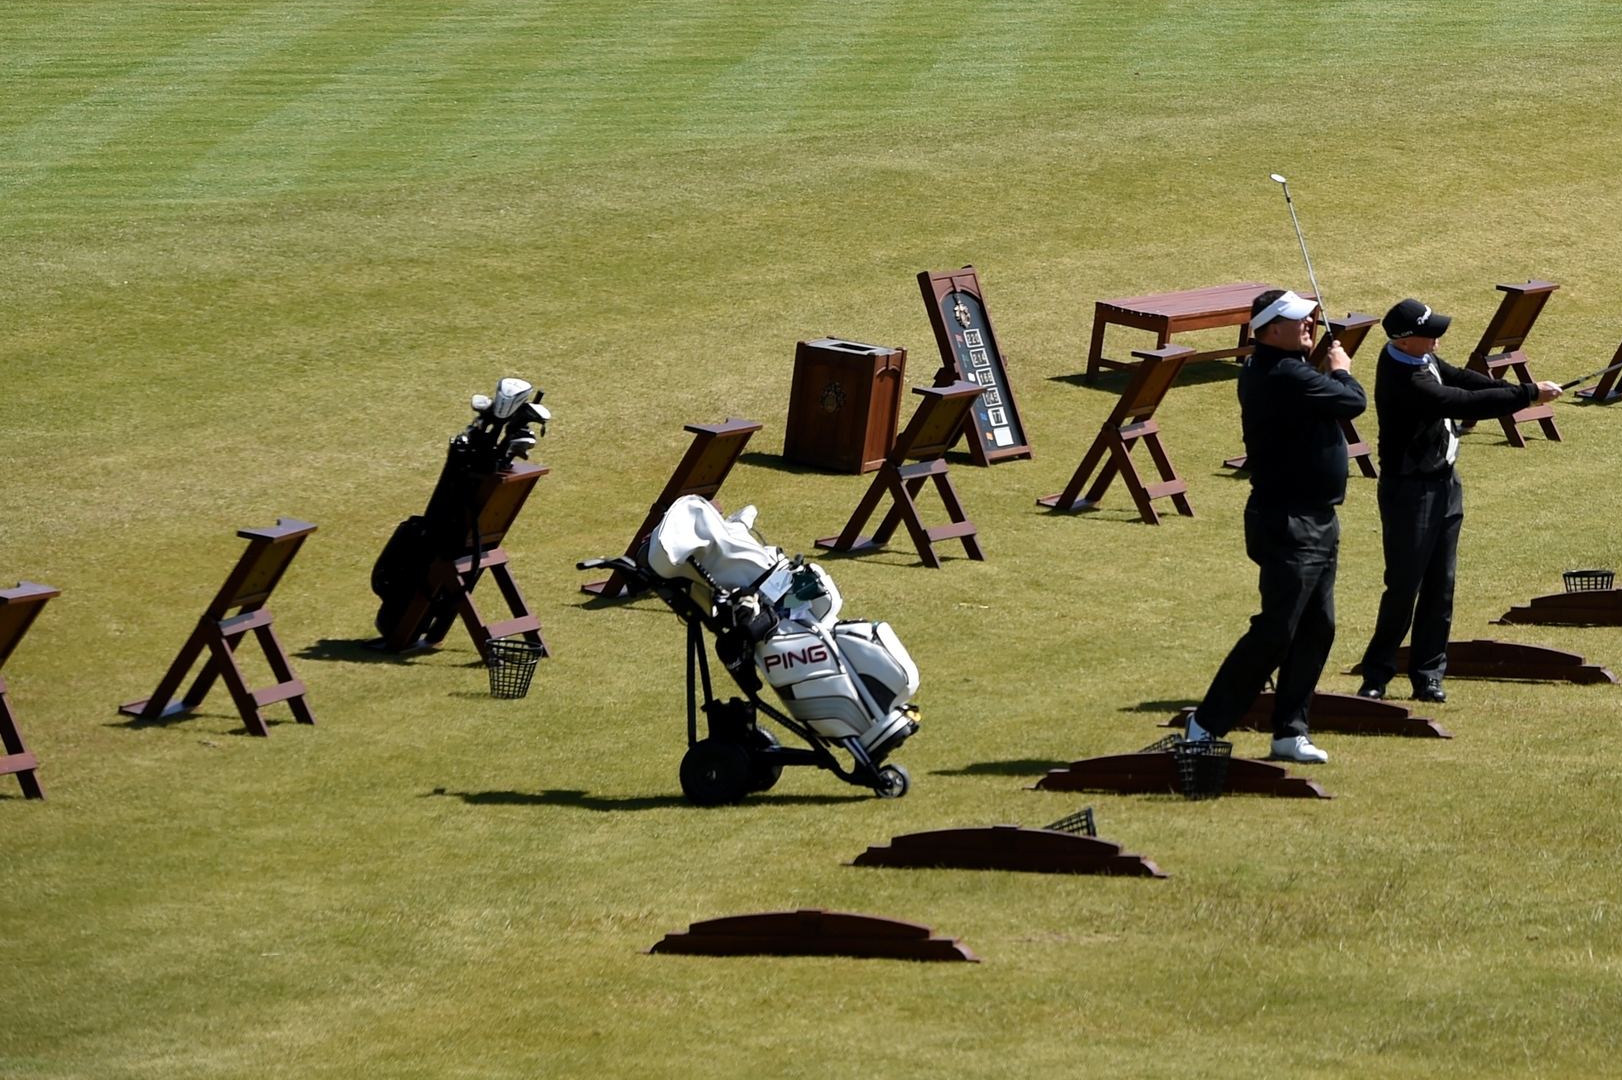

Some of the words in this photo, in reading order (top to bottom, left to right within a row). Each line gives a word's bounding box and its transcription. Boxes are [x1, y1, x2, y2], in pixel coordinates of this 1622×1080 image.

[967, 333, 980, 344] 220
[973, 352, 986, 364] 214
[763, 645, 827, 673] PING
